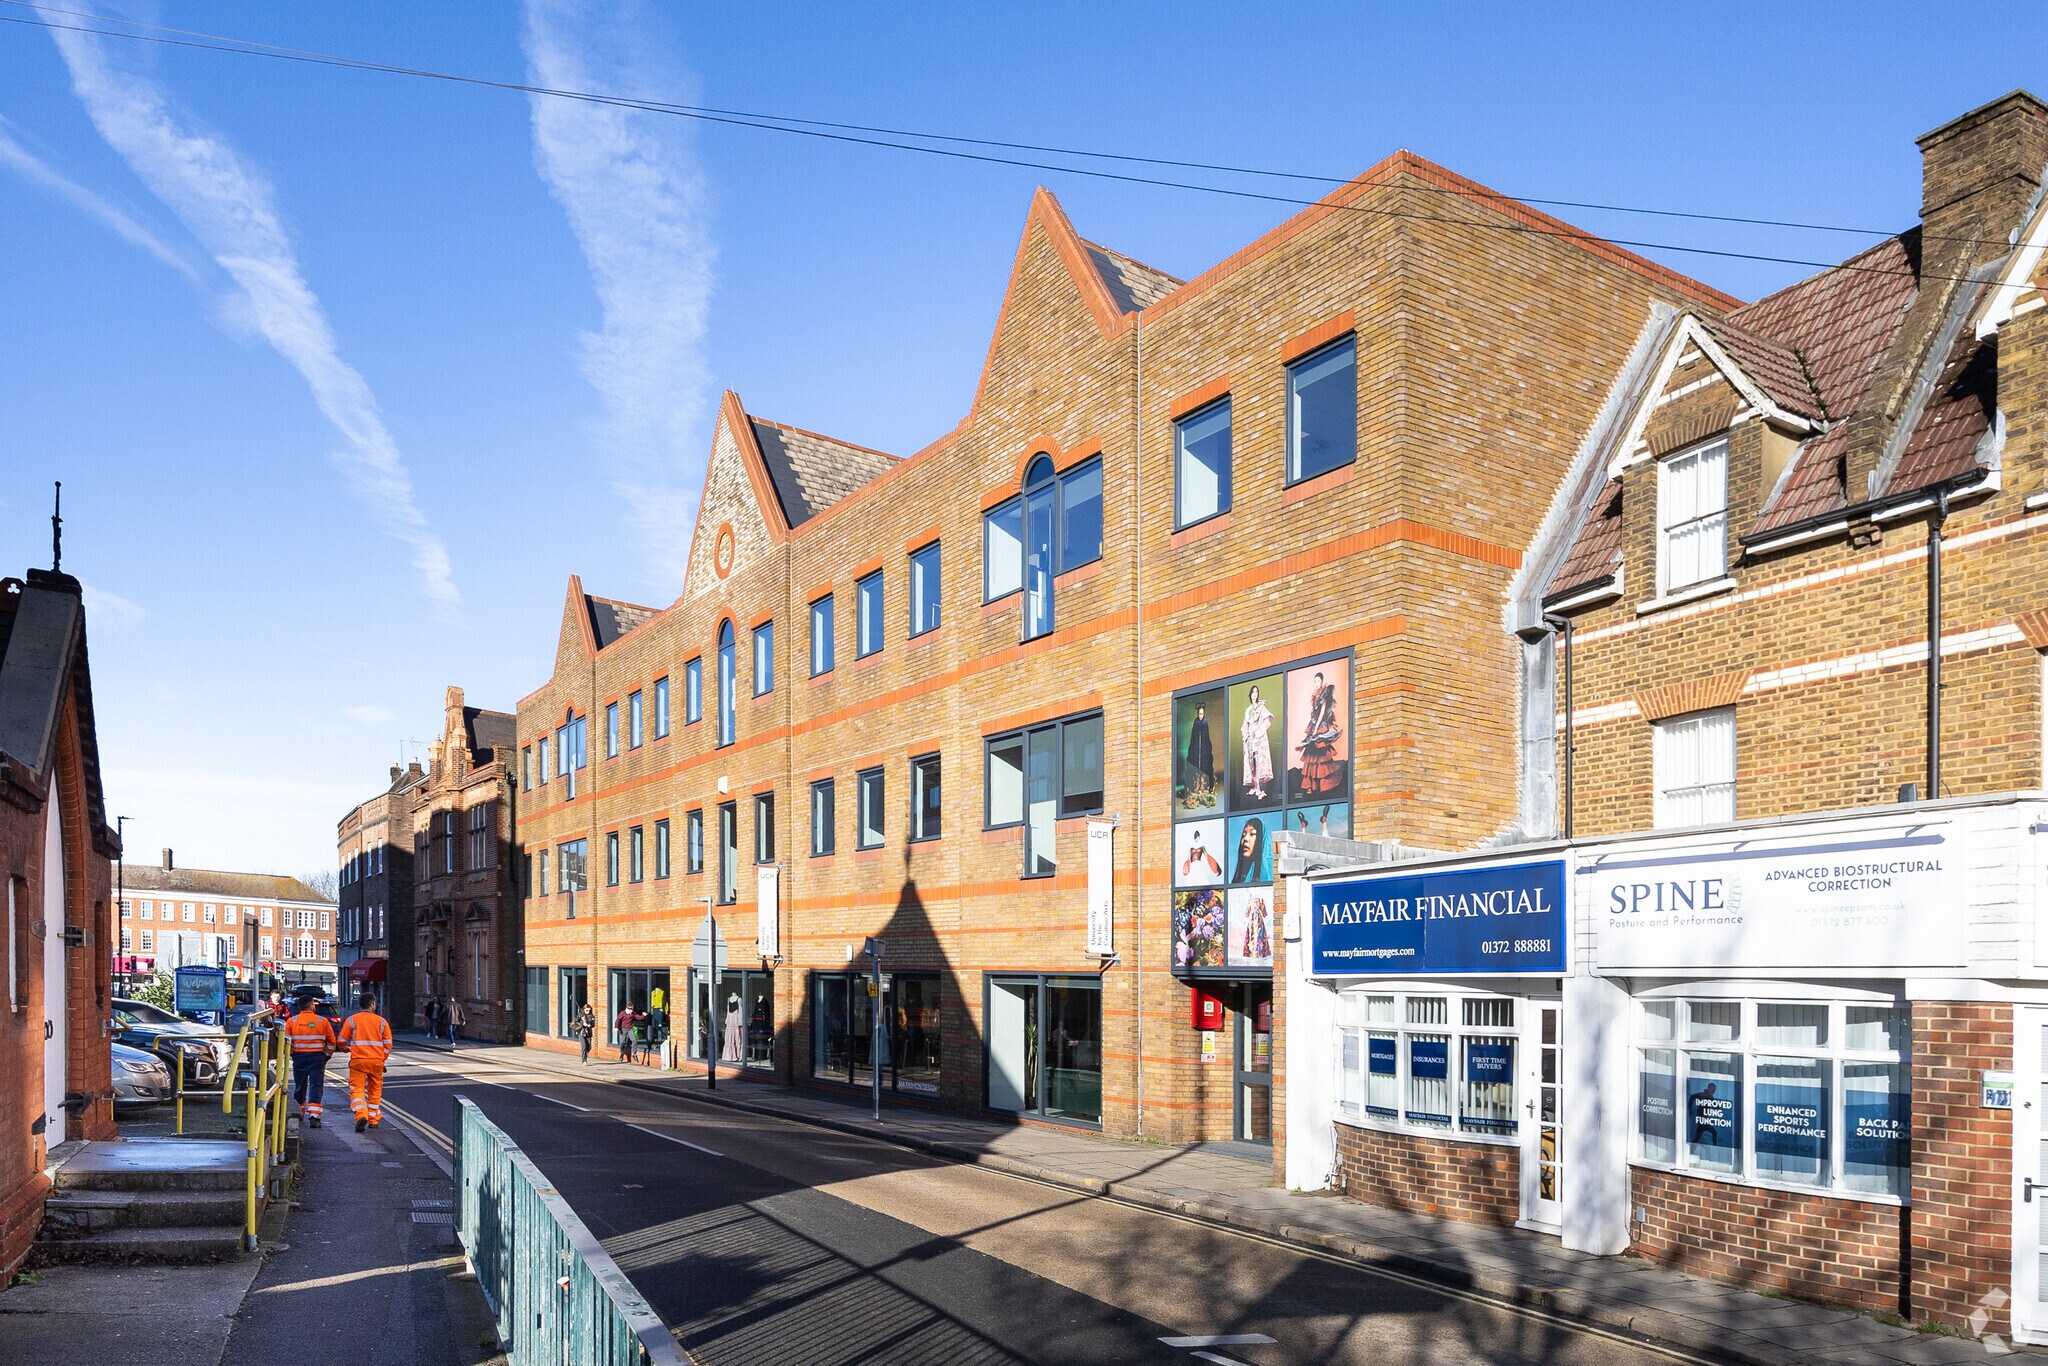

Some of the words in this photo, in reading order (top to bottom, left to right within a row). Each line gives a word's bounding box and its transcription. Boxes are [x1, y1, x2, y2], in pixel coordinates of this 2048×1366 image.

[1090, 830, 1109, 839] UCA
[1765, 867, 1829, 881] ADVANCED
[1834, 860, 1943, 877] BIOSTRUCTURAL
[1808, 877, 1892, 893] CORRECTION
[1610, 878, 1724, 914] SPINE
[1321, 898, 1412, 926] MAYFAIR
[1415, 887, 1551, 920] FINANCIAL
[1609, 918, 1645, 928] Posture
[1649, 916, 1669, 927] and
[1673, 914, 1743, 926] Performance
[1843, 917, 1862, 926] 877
[1322, 946, 1415, 959] www.mayfairmortgages.com
[1481, 940, 1510, 954] 01372
[1514, 939, 1551, 953] 888881
[1413, 1056, 1446, 1064] INSURANCES
[1646, 1097, 1669, 1107] POSTURE
[1695, 1099, 1732, 1109] IMPROVED
[1642, 1105, 1674, 1116] CORRECTION
[1703, 1108, 1724, 1117] LUNG
[1766, 1105, 1817, 1117] ENHANCED
[1486, 1119, 1514, 1127] FINANCIAL
[1695, 1117, 1732, 1128] FUNCTION
[1773, 1115, 1810, 1127] SPORTS
[1858, 1117, 1889, 1129] BACK
[1758, 1123, 1826, 1139] PERFORMANCE
